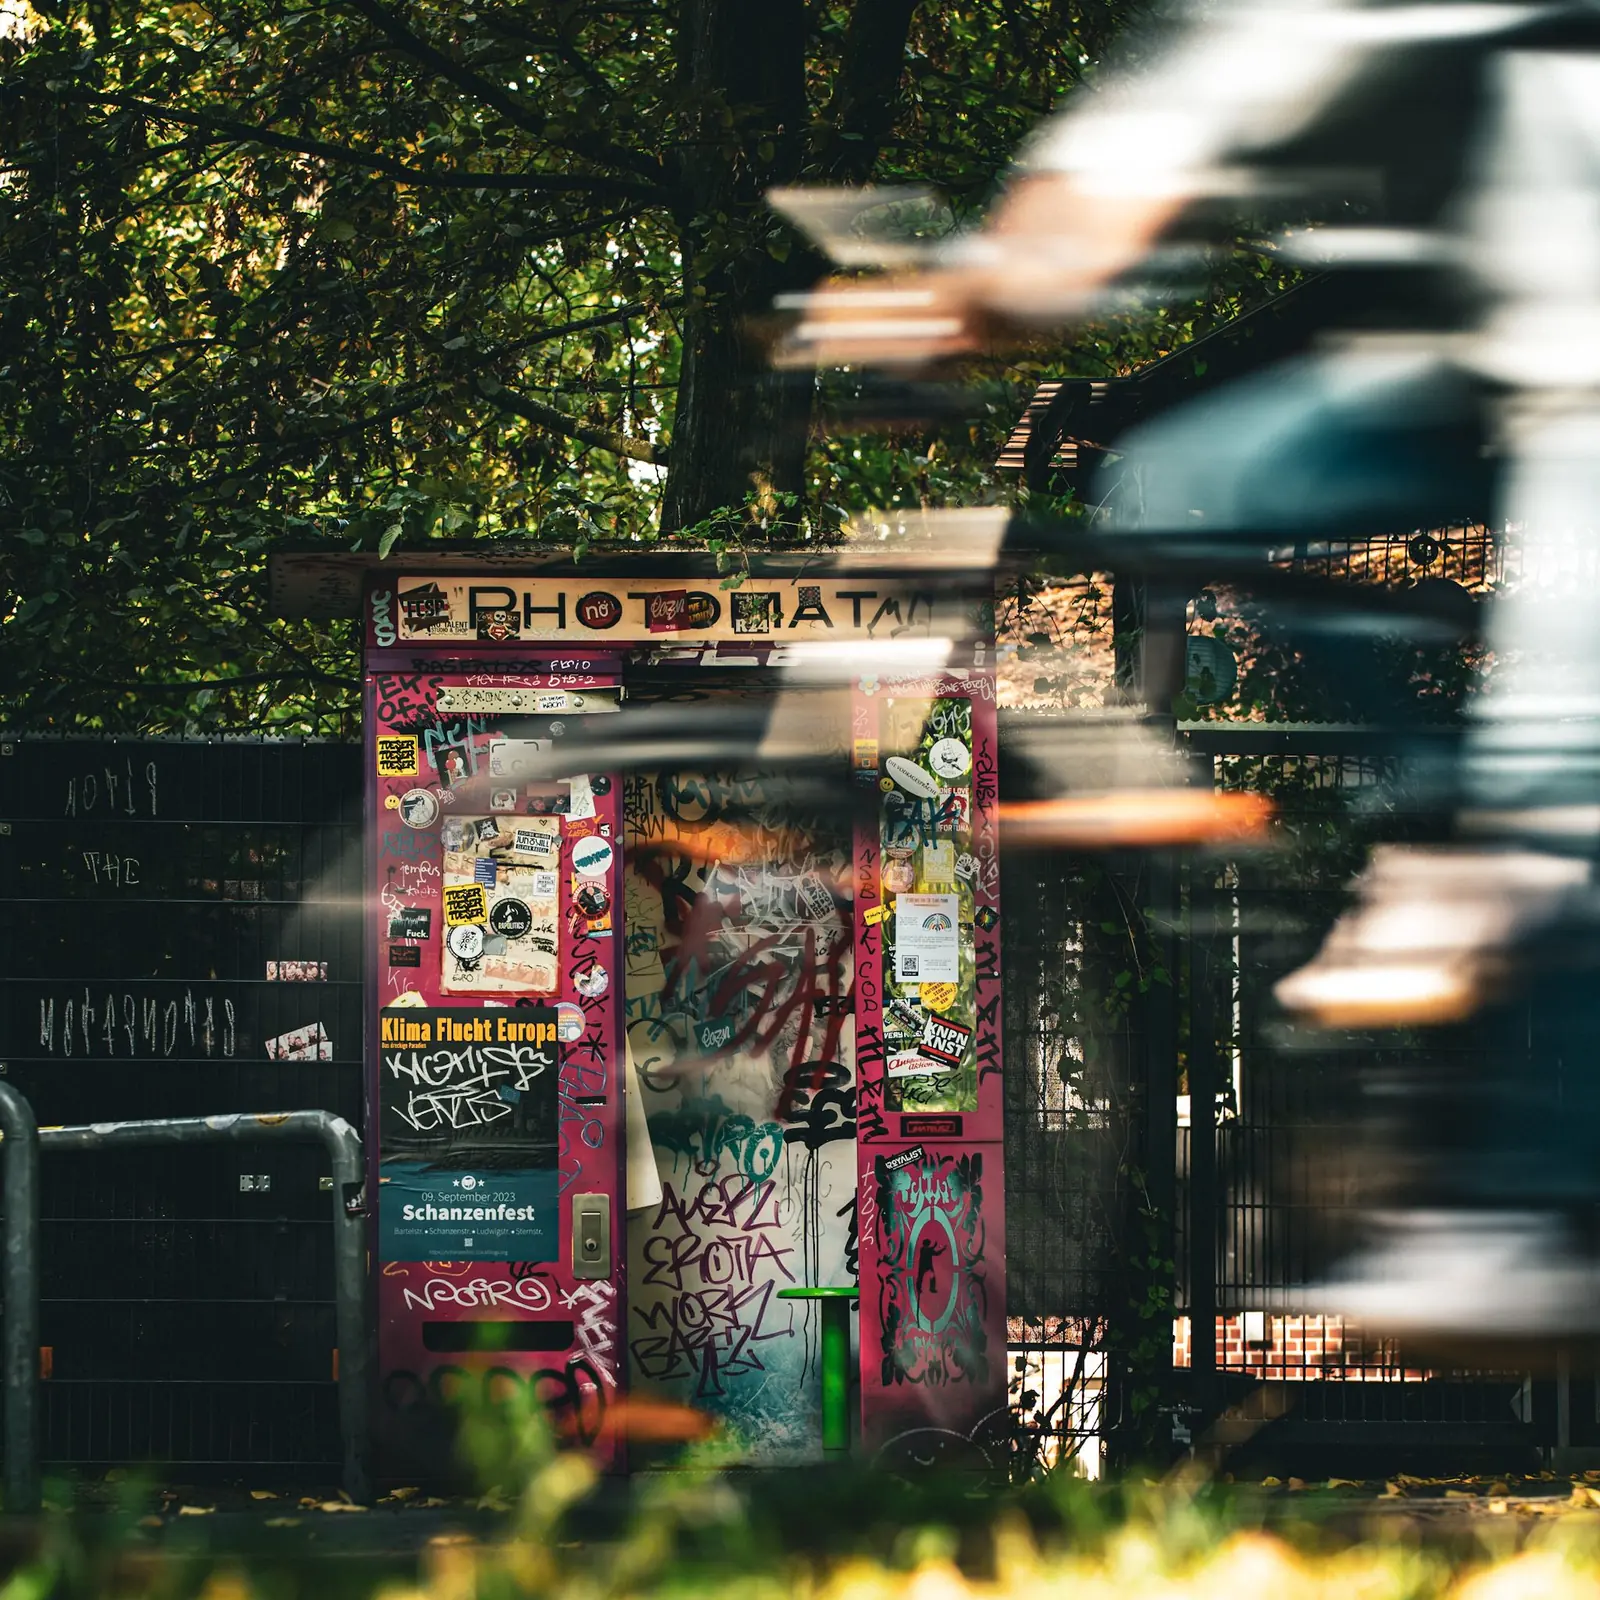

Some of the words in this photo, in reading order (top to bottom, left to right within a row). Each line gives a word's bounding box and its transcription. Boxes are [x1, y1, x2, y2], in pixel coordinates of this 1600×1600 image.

[939, 824, 970, 832] FORTUNA
[406, 928, 429, 938] Fuck.
[381, 1017, 431, 1041] Klima
[436, 1017, 492, 1041] Flucht
[497, 1017, 556, 1048] Europa
[927, 1021, 969, 1047] KNPN
[391, 1042, 408, 1050] dreckige
[921, 1033, 966, 1057] KNST
[884, 1147, 922, 1170] ROYALIST
[421, 1192, 435, 1202] 09.
[438, 1191, 490, 1204] September
[492, 1191, 516, 1202] 2023
[402, 1204, 535, 1221] Schanzenfest
[394, 1227, 423, 1235] Bartelstr.
[429, 1227, 472, 1235] Schanzenstr.
[476, 1227, 511, 1237] Ludwigstr.
[515, 1227, 543, 1235] Sternstr.
